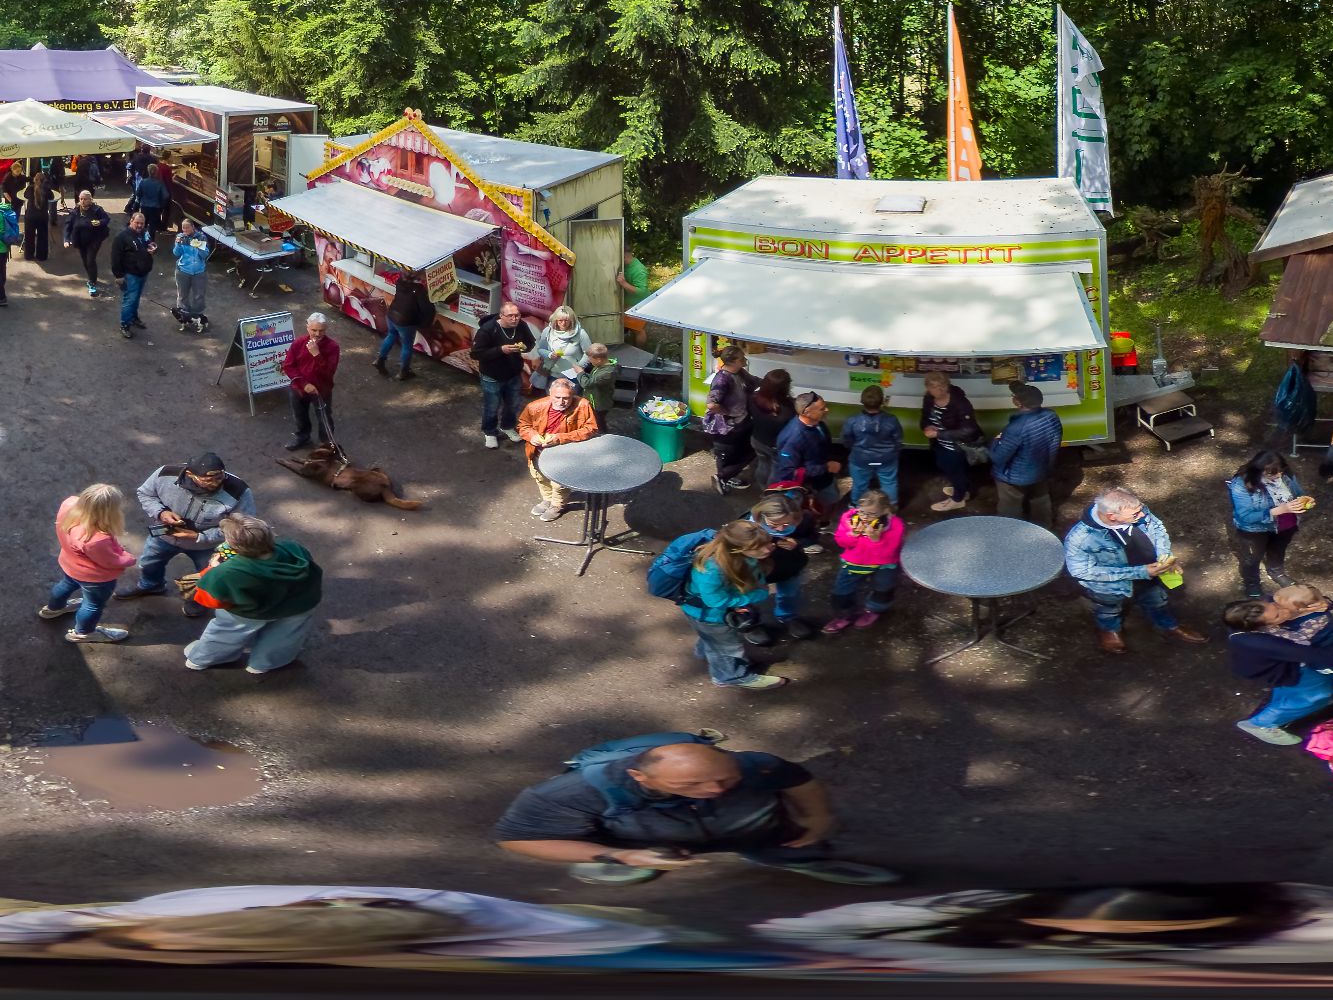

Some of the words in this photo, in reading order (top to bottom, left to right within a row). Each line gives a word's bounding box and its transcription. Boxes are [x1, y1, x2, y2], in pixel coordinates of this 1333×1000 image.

[22, 121, 79, 136] Eibauer
[253, 116, 269, 127] 450
[753, 234, 830, 260] BON
[853, 243, 1023, 265] APPETIT
[427, 261, 454, 281] SCHOKO
[246, 334, 294, 350] Zuckerwatte
